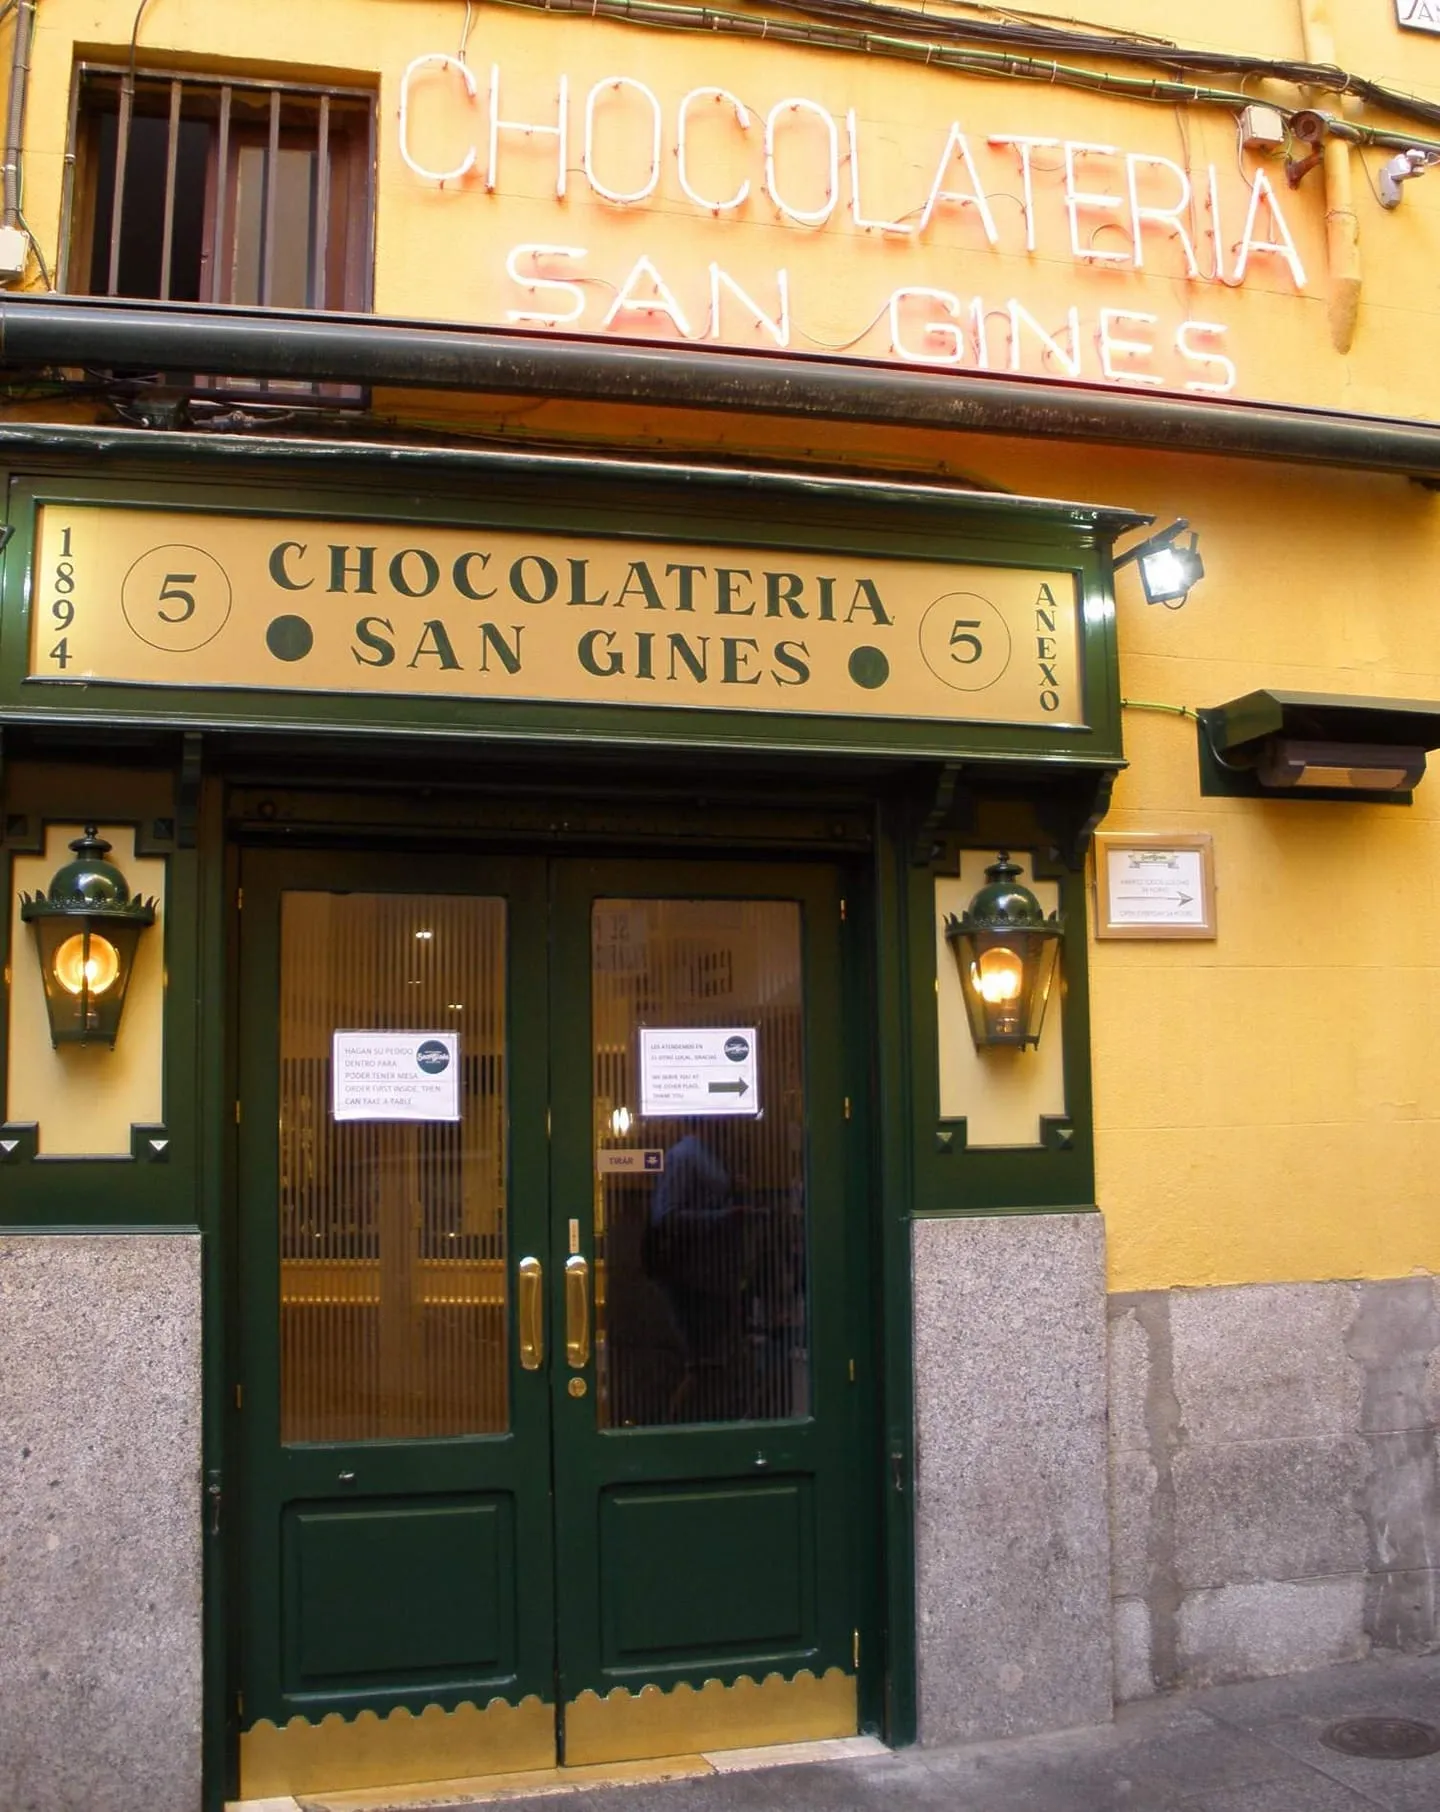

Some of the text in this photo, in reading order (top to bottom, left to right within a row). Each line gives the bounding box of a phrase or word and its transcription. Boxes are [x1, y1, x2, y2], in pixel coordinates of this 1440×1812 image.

[399, 53, 1308, 289] CHOCOLATERIA
[506, 244, 1236, 393] SAN GINES
[49, 527, 75, 669] 1894
[158, 573, 197, 623] 5
[268, 541, 894, 626] CHOCOLATERIA
[351, 616, 811, 687] SAN GINES
[949, 619, 983, 664] 5
[1035, 582, 1060, 712] ANEXO
